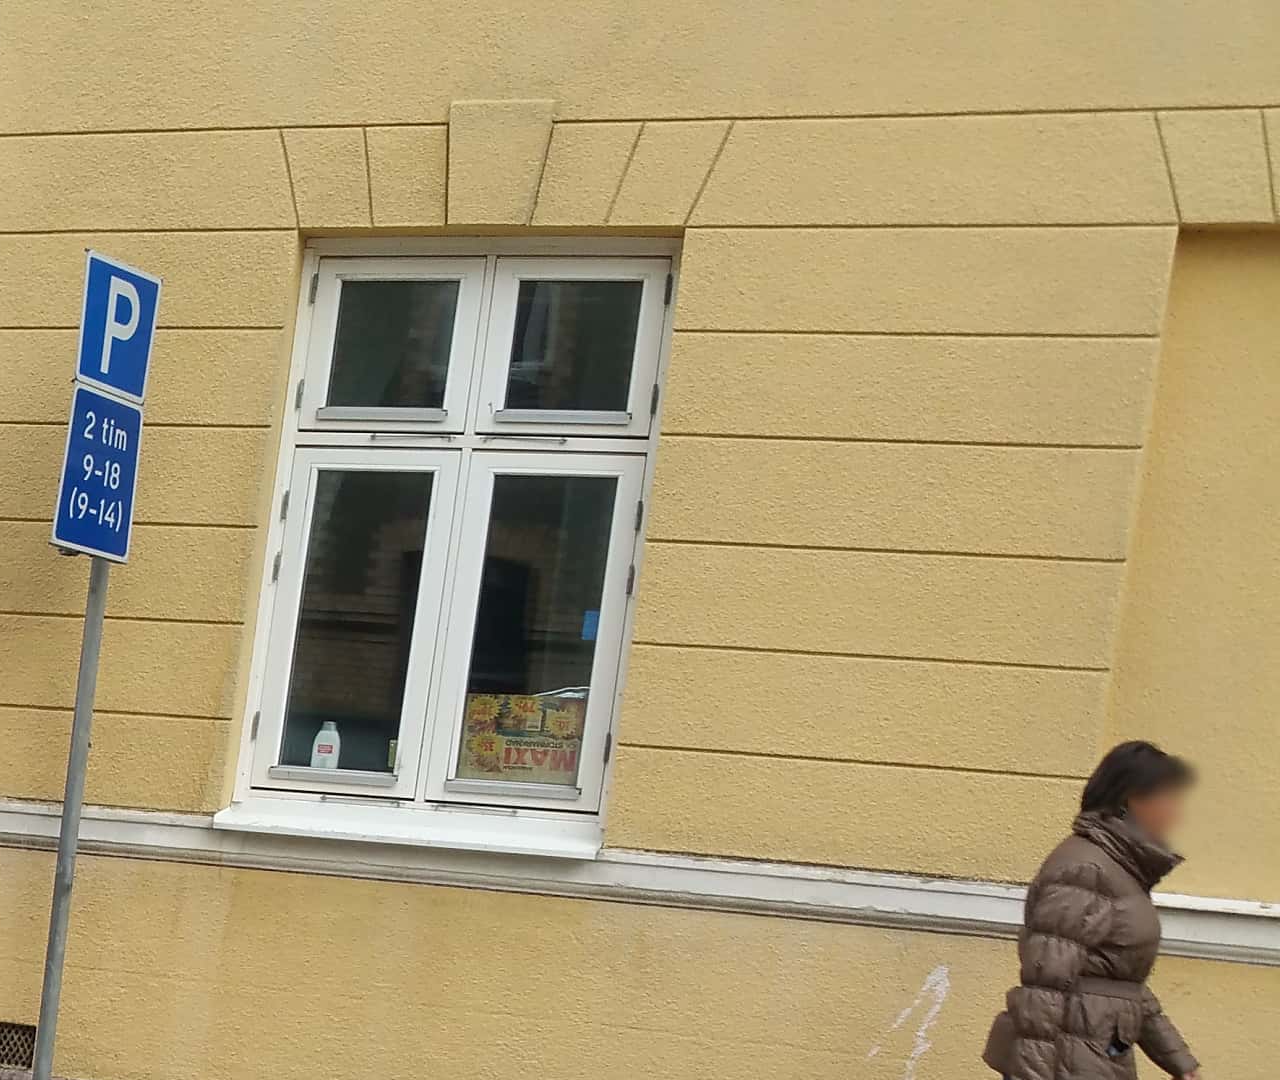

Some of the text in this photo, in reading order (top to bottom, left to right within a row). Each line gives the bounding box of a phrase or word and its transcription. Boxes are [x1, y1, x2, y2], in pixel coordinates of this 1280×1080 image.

[100, 275, 141, 374] P
[83, 411, 128, 452] 2 tim
[82, 454, 121, 490] 9-18
[69, 487, 123, 533] (9-14)
[503, 747, 577, 771] MAXI
